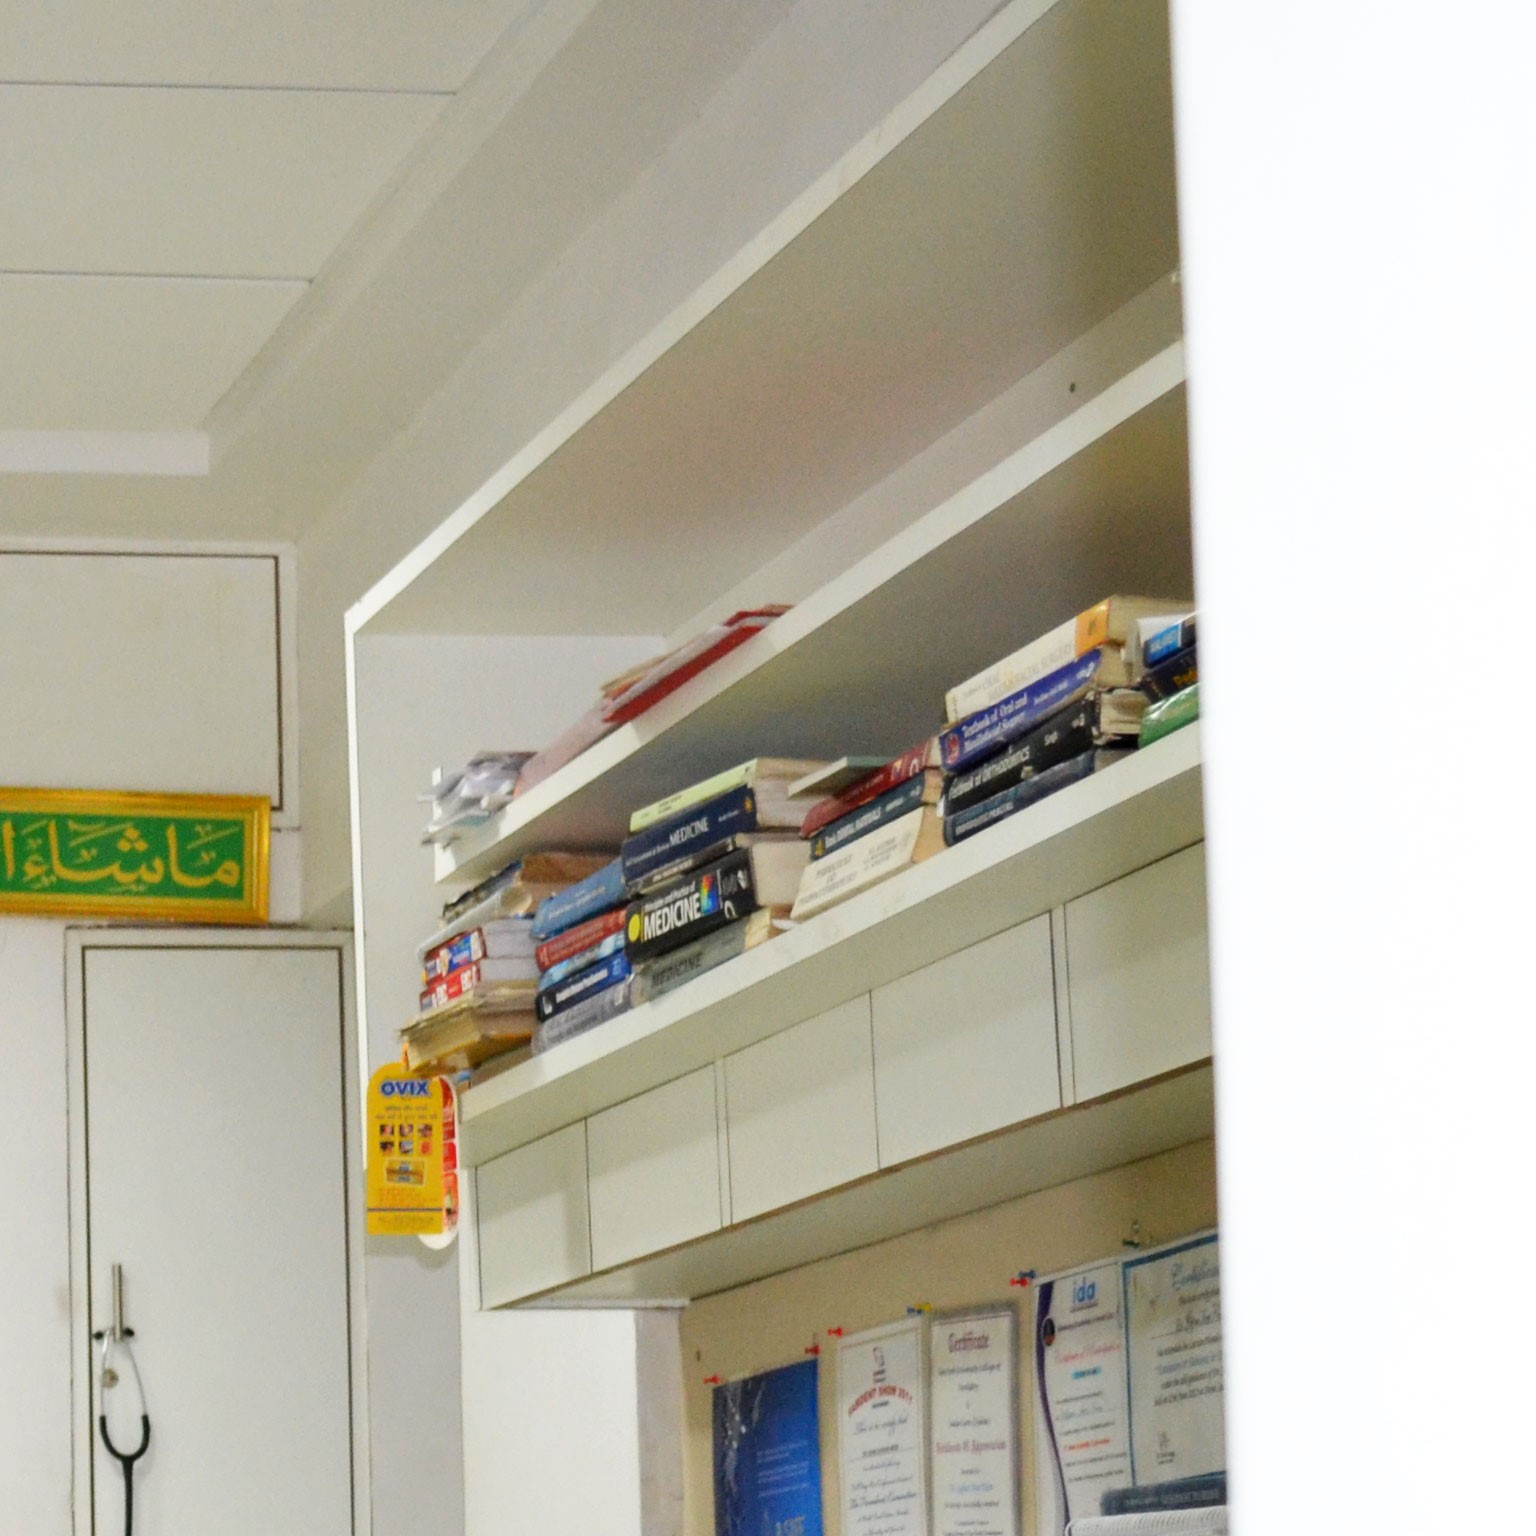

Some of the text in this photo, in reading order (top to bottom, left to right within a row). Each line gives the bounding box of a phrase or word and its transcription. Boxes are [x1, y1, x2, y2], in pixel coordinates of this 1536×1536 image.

[669, 817, 709, 846] MEDICINE
[644, 892, 701, 941] MEDICINE
[652, 955, 702, 988] MEDICINE
[381, 1080, 430, 1097] OVIX
[1072, 1276, 1096, 1304] ida
[948, 1331, 990, 1353] Certificate
